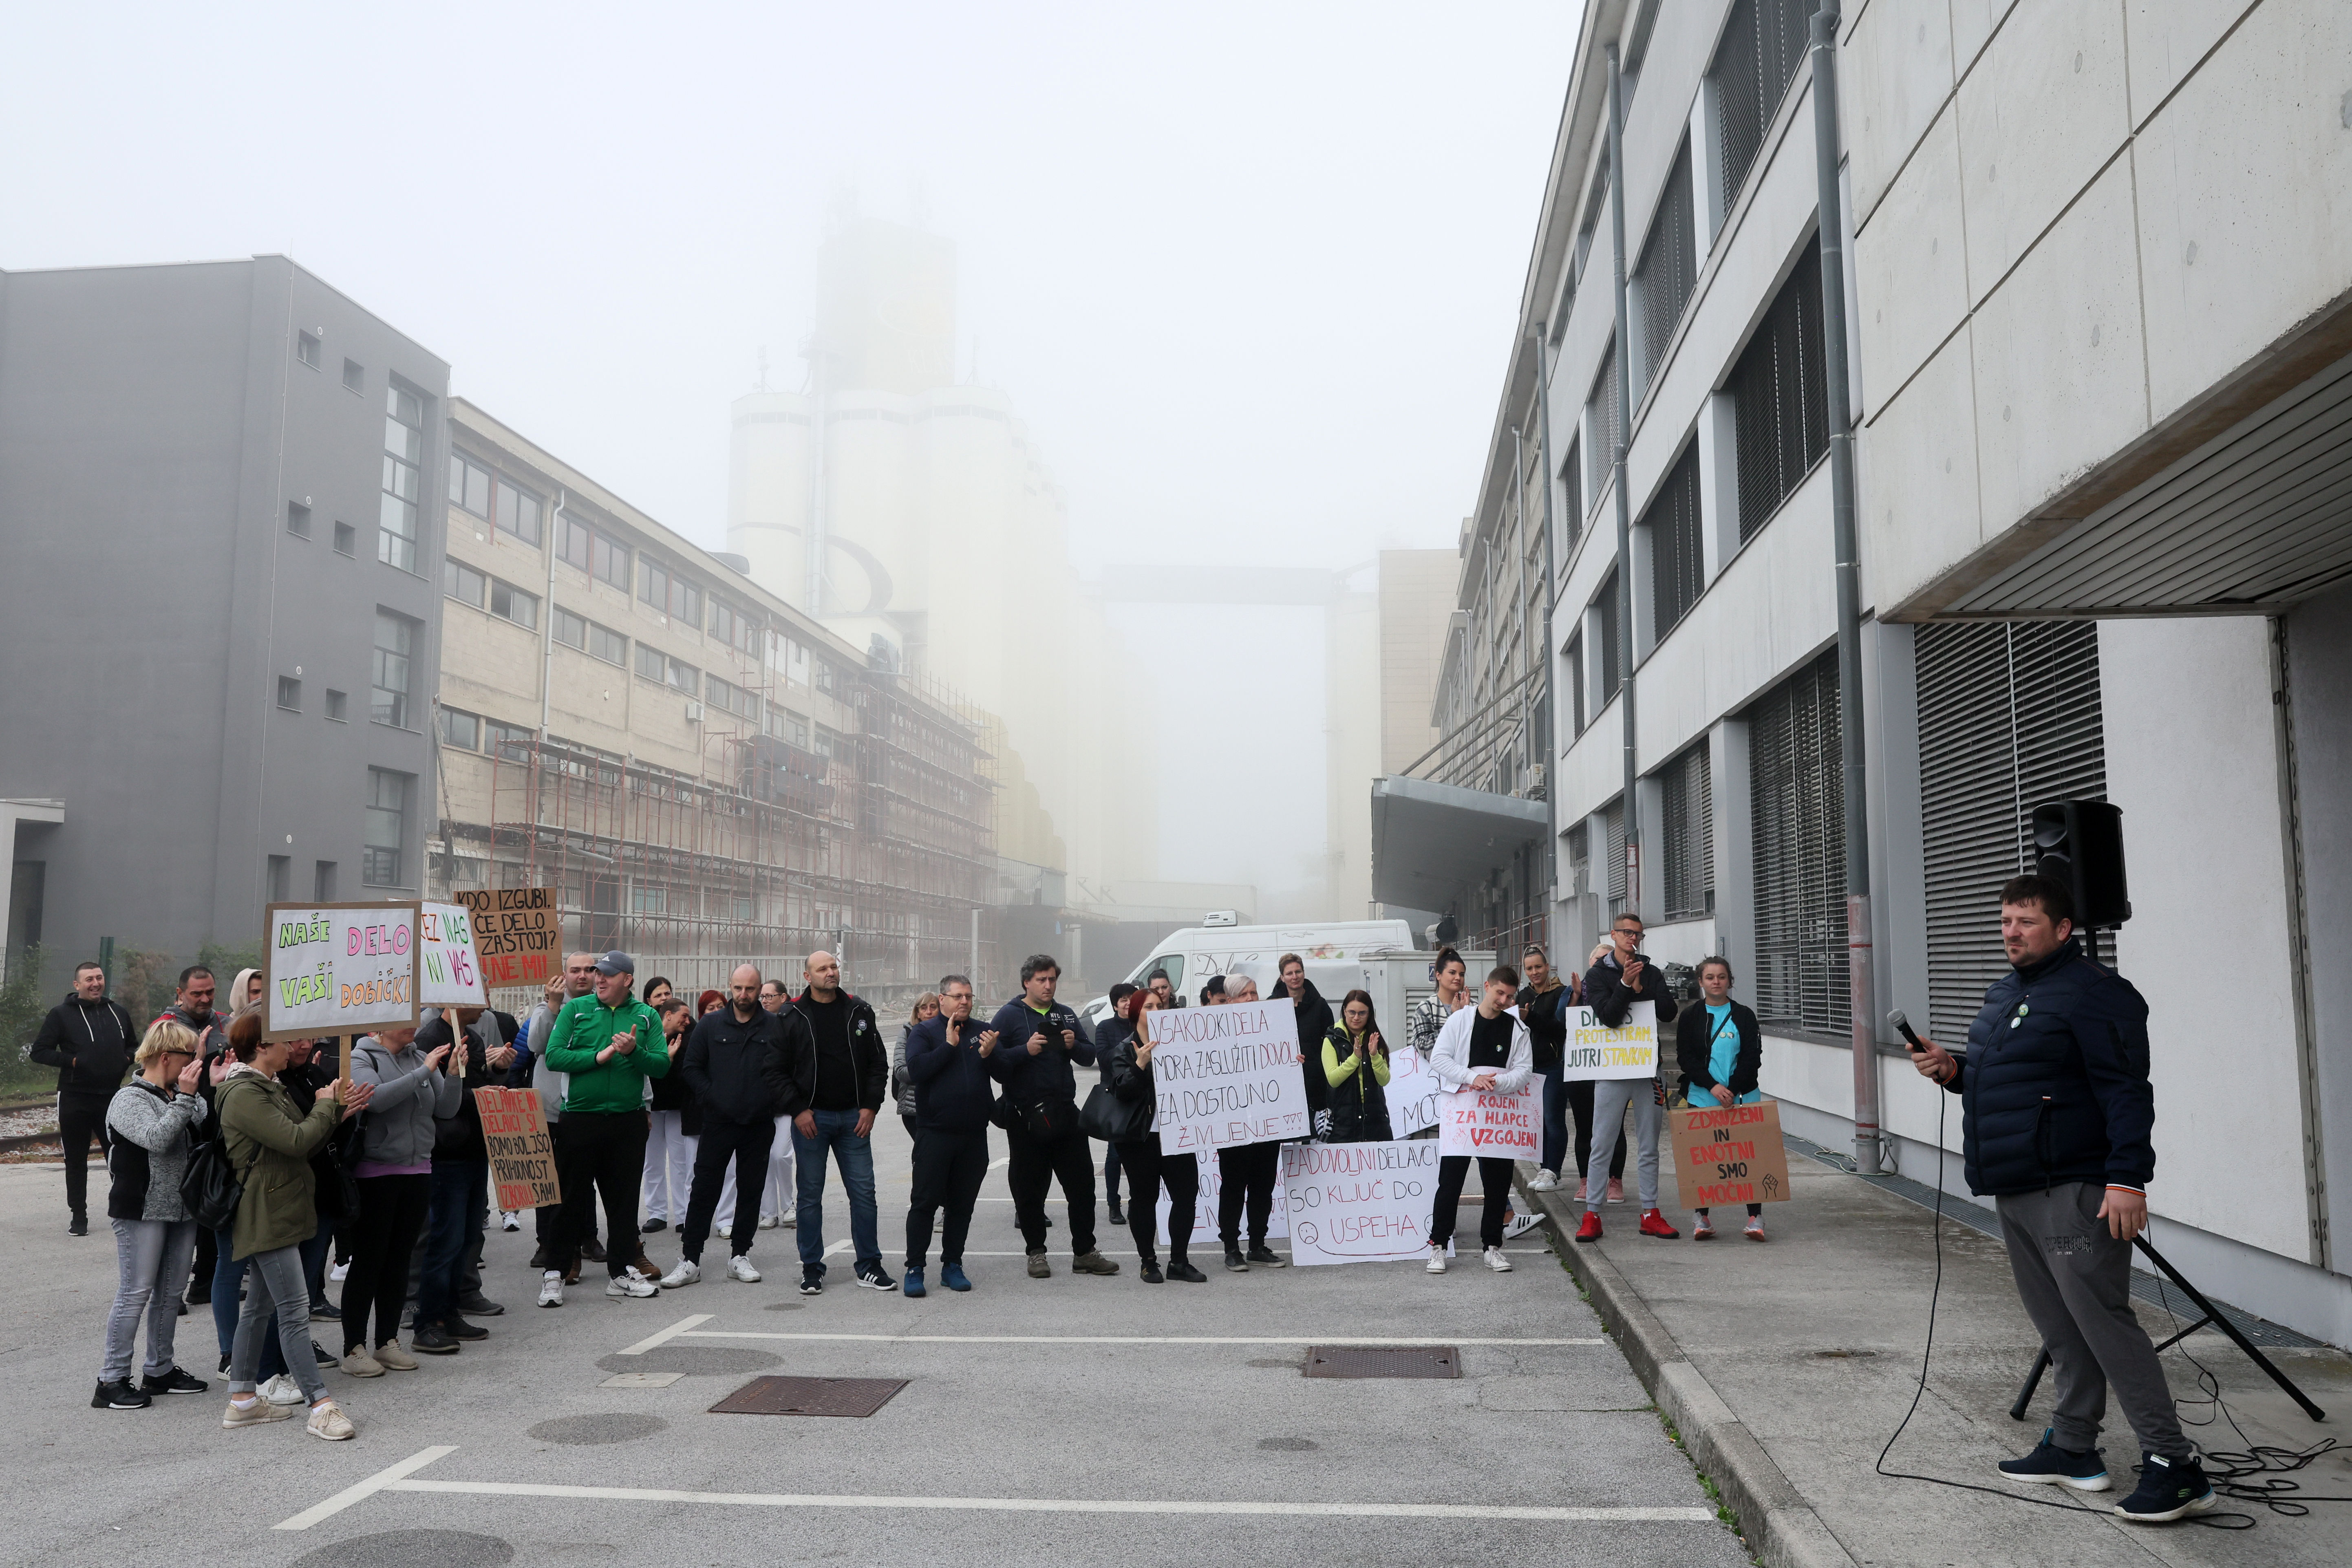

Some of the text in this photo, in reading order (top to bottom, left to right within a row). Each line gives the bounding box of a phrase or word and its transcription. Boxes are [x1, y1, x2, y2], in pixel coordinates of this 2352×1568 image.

[457, 889, 550, 911] KDO IZGUBI,
[279, 913, 410, 955] NAŠE DELO
[442, 912, 468, 944] NAS
[474, 912, 545, 934] ČE DELO
[479, 930, 556, 955] ZASTOJI?
[425, 948, 474, 987] NI VAS
[491, 956, 518, 982] NE
[521, 955, 547, 979] MI!
[1233, 1010, 1269, 1036] DELA
[1581, 1008, 1633, 1027] DAS
[1575, 1025, 1653, 1045] PROTESTIRAM,
[1154, 1055, 1194, 1083] MORA
[1195, 1043, 1256, 1078] ZASLUŽITI
[1567, 1047, 1653, 1068] JUTRI STAVKAM
[475, 1090, 538, 1114] DELAVKE IN
[1158, 1079, 1280, 1126] ZA DOSTOJNO
[1477, 1094, 1519, 1110] ROJENI
[483, 1113, 537, 1134] DELAVCI SI
[1456, 1110, 1477, 1124] ZA
[1485, 1111, 1528, 1127] HLAPCE
[1686, 1106, 1764, 1130] ZDRUŽENI
[1178, 1117, 1279, 1148] ŽIVLJENJE
[1714, 1128, 1730, 1142] IN
[487, 1135, 512, 1158] BOMO
[1690, 1141, 1755, 1165] ENOTNI
[494, 1159, 547, 1182] PRIHODNOST
[1284, 1145, 1438, 1177] ZADOVOLJNI DELAVCI
[1717, 1162, 1747, 1179] SMO
[499, 1182, 556, 1209] IZBORILI SAMI
[1290, 1186, 1321, 1212] SO
[1327, 1179, 1384, 1204] KLJUČ
[1394, 1181, 1422, 1200] DO
[1697, 1180, 1754, 1205] MOČNI
[1330, 1215, 1419, 1244] USPEHA
